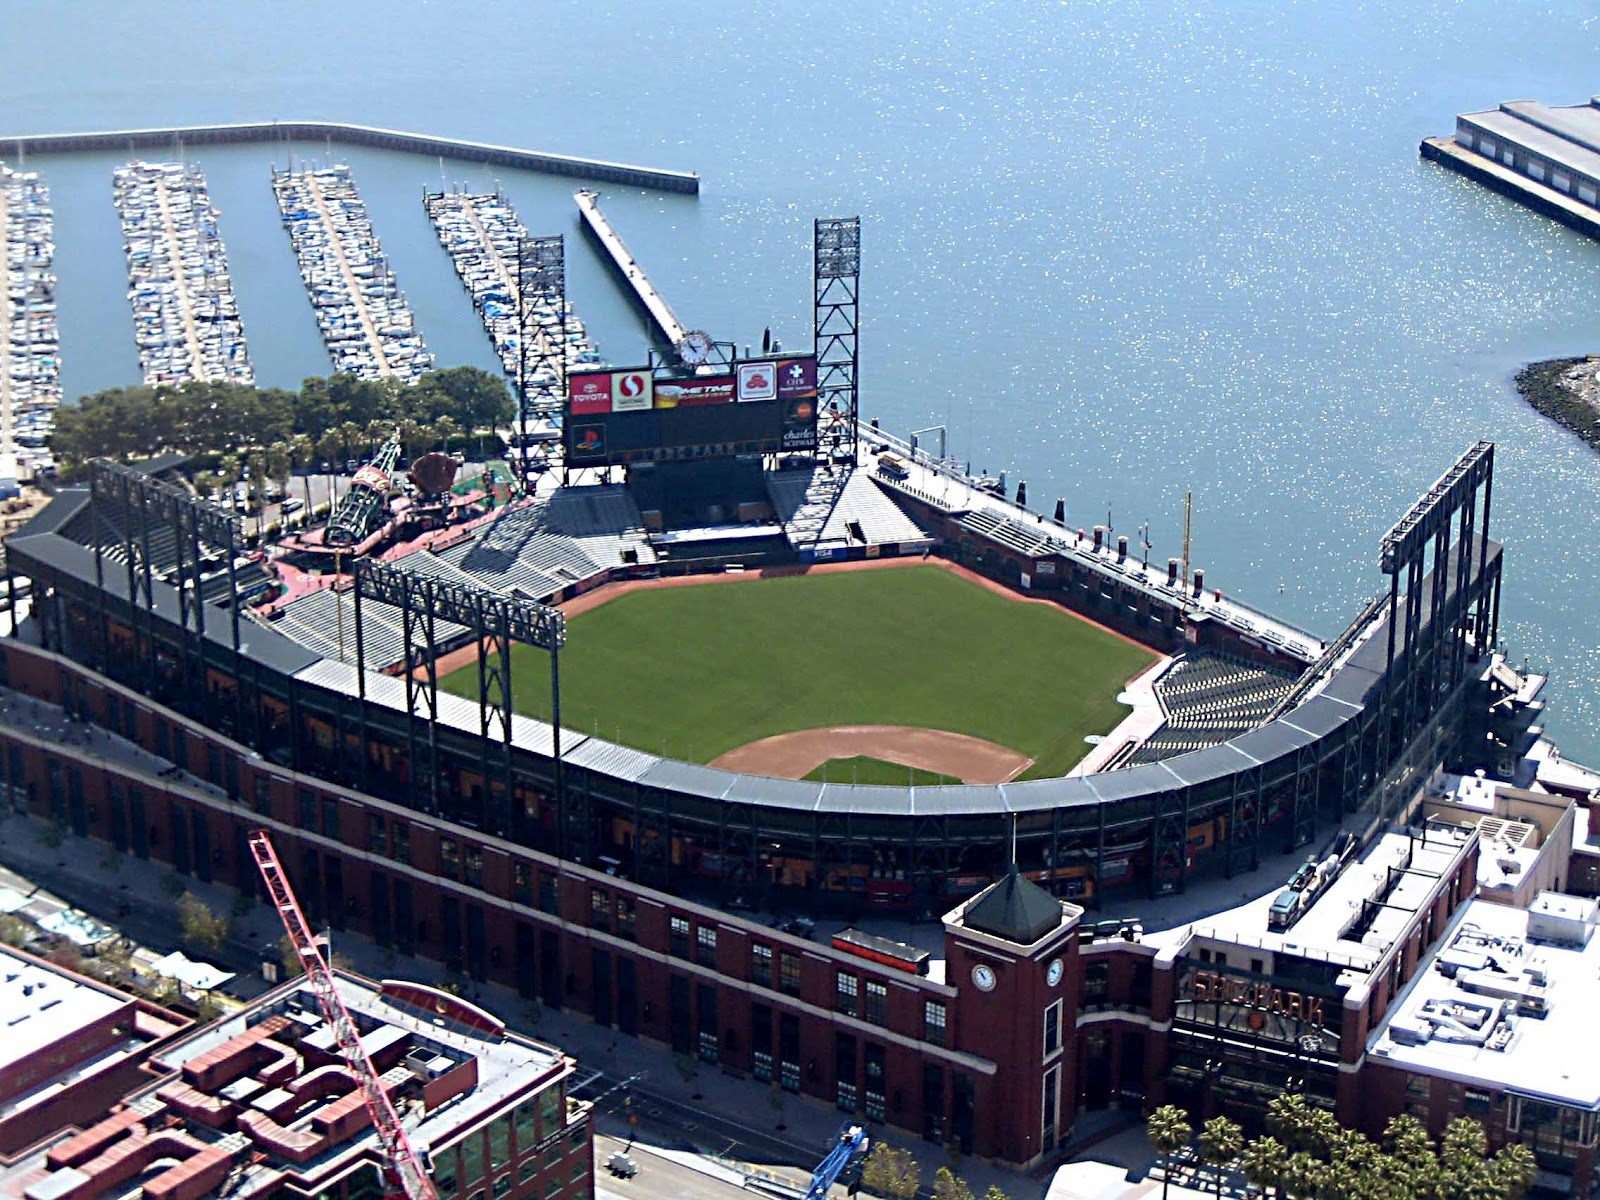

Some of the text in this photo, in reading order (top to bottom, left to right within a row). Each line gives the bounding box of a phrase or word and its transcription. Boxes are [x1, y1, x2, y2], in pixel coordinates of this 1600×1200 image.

[573, 392, 609, 403] TOYOTA
[783, 428, 815, 440] charles
[692, 442, 736, 457] PARK
[1190, 970, 1326, 1028] SBC PARK
